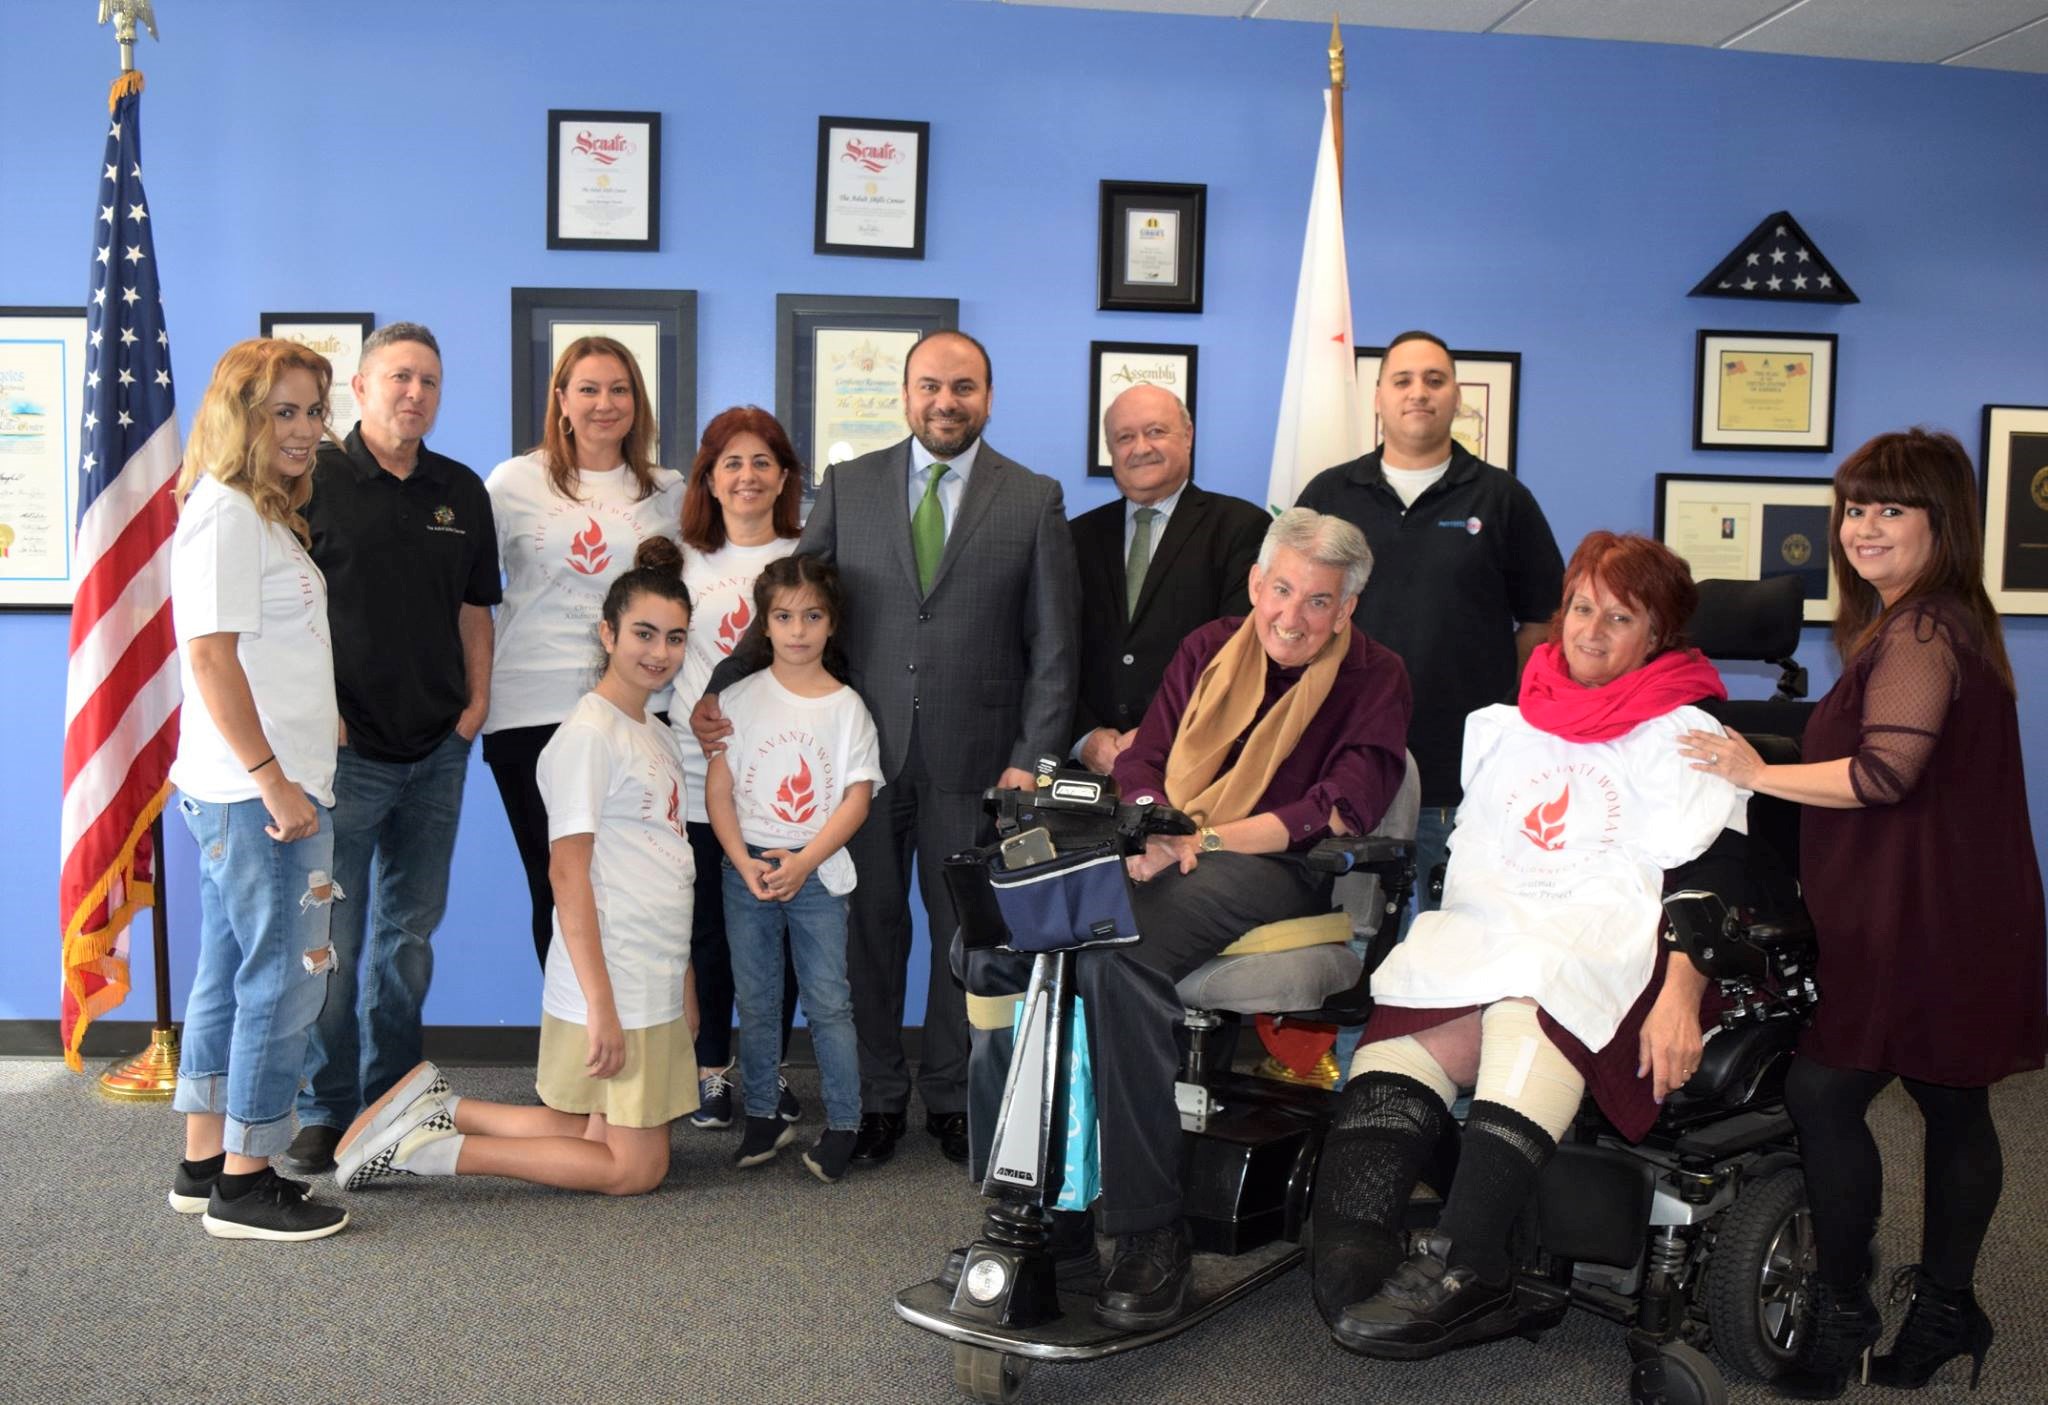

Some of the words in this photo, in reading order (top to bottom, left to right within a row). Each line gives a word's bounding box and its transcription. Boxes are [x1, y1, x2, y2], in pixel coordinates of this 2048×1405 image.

[571, 130, 628, 157] Senate
[841, 138, 898, 162] Senate
[1111, 363, 1177, 385] Assembly
[758, 731, 815, 758] AVANTI
